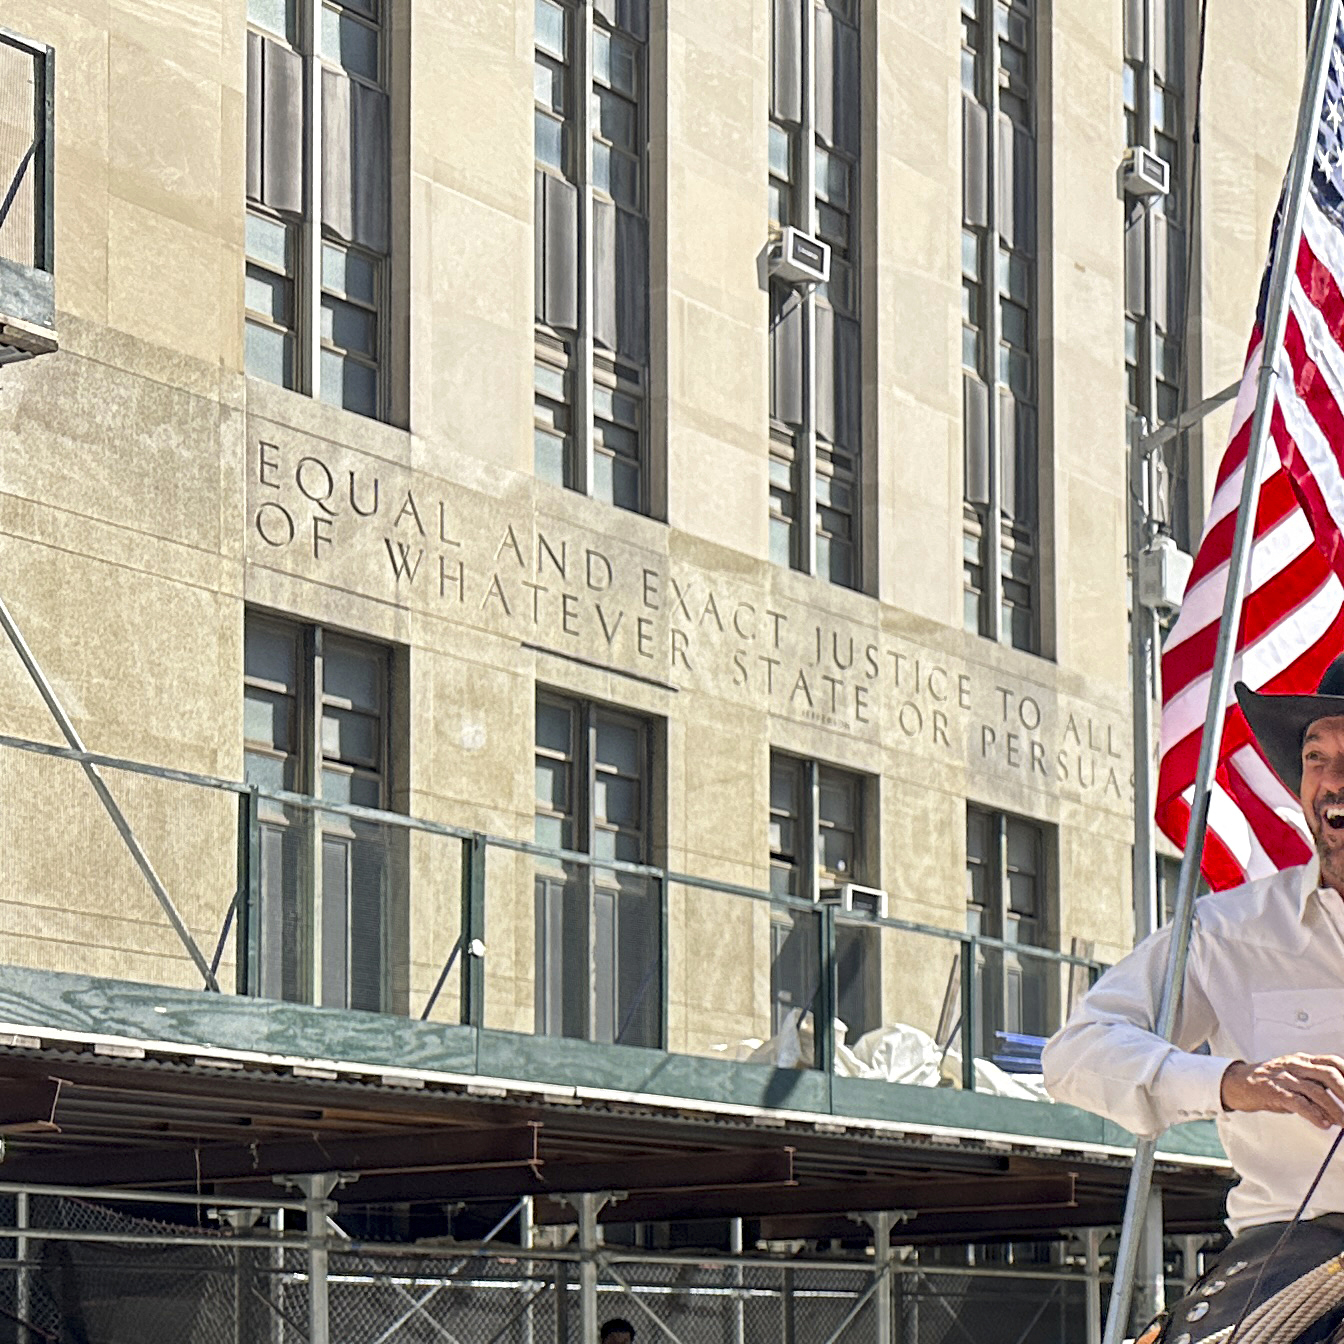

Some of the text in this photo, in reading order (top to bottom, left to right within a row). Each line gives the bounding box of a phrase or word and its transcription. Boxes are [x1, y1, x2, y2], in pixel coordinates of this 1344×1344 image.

[255, 501, 333, 559] OF
[384, 536, 693, 671] WHATEVER
[732, 648, 870, 725] STATE
[899, 701, 951, 747] OR
[258, 440, 461, 549] EQUAL
[494, 523, 613, 592] AND
[643, 568, 788, 649] EXACT
[813, 626, 972, 711] JUSTICE
[995, 685, 1041, 731] TO
[1063, 712, 1122, 759] ALL
